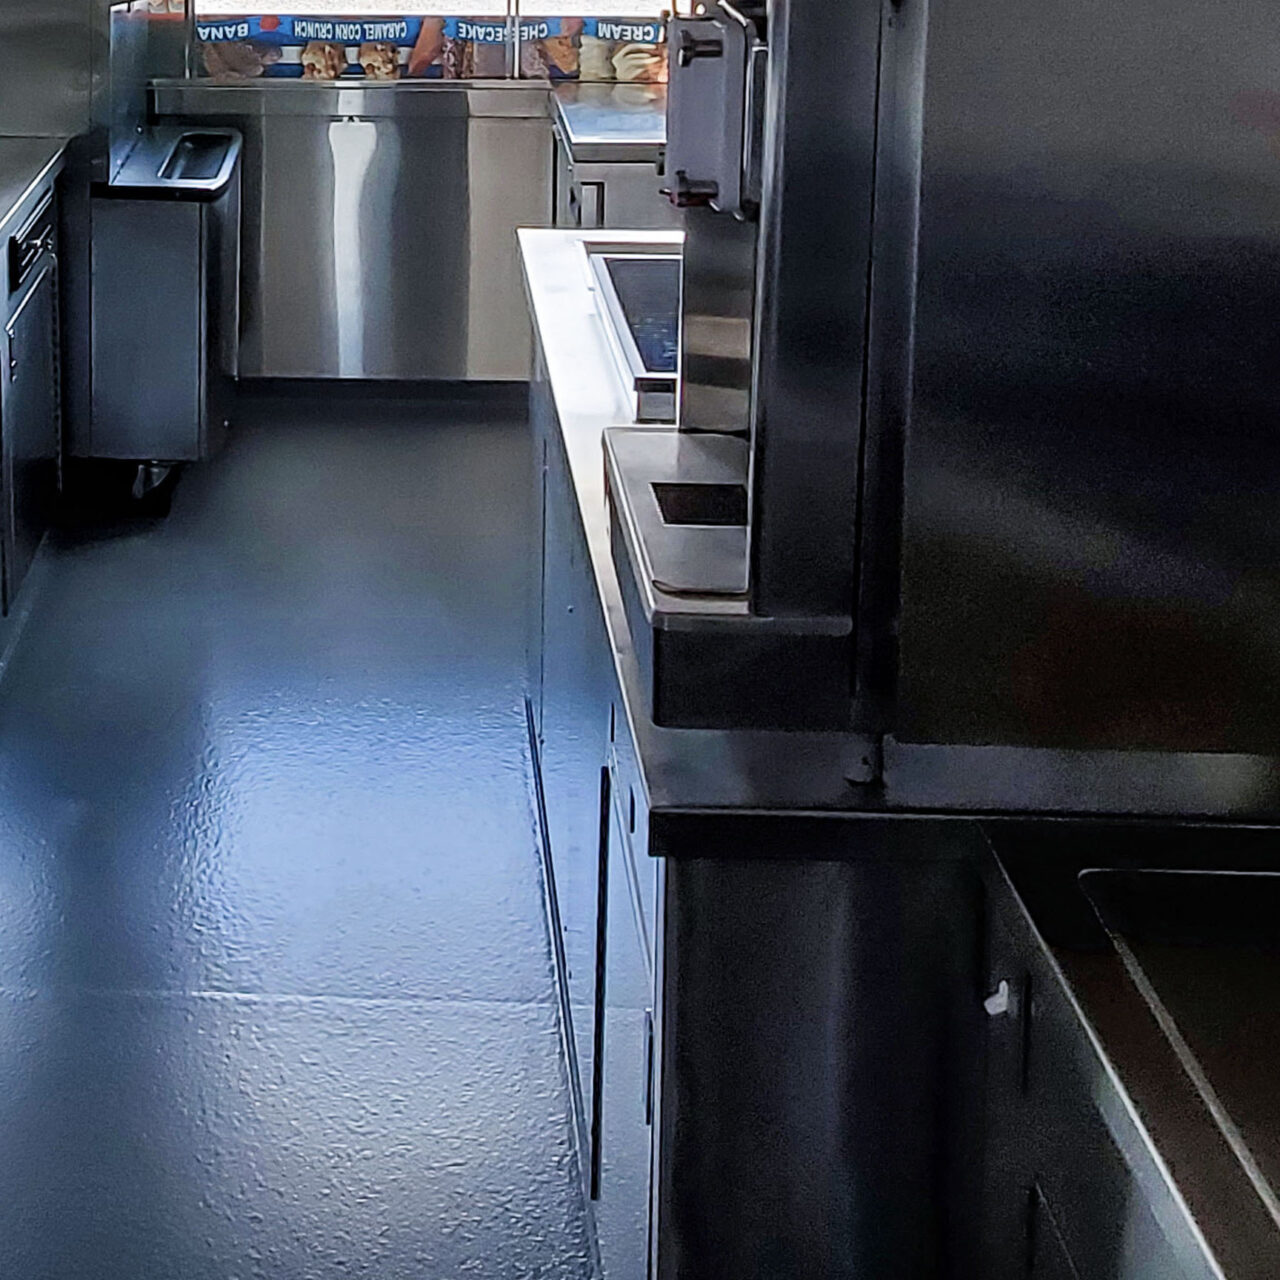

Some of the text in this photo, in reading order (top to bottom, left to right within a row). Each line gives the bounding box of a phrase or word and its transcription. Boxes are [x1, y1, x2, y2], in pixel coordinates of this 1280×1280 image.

[294, 21, 407, 39] CARAMEL CORN CRUNCH
[598, 22, 654, 41] CREAM
